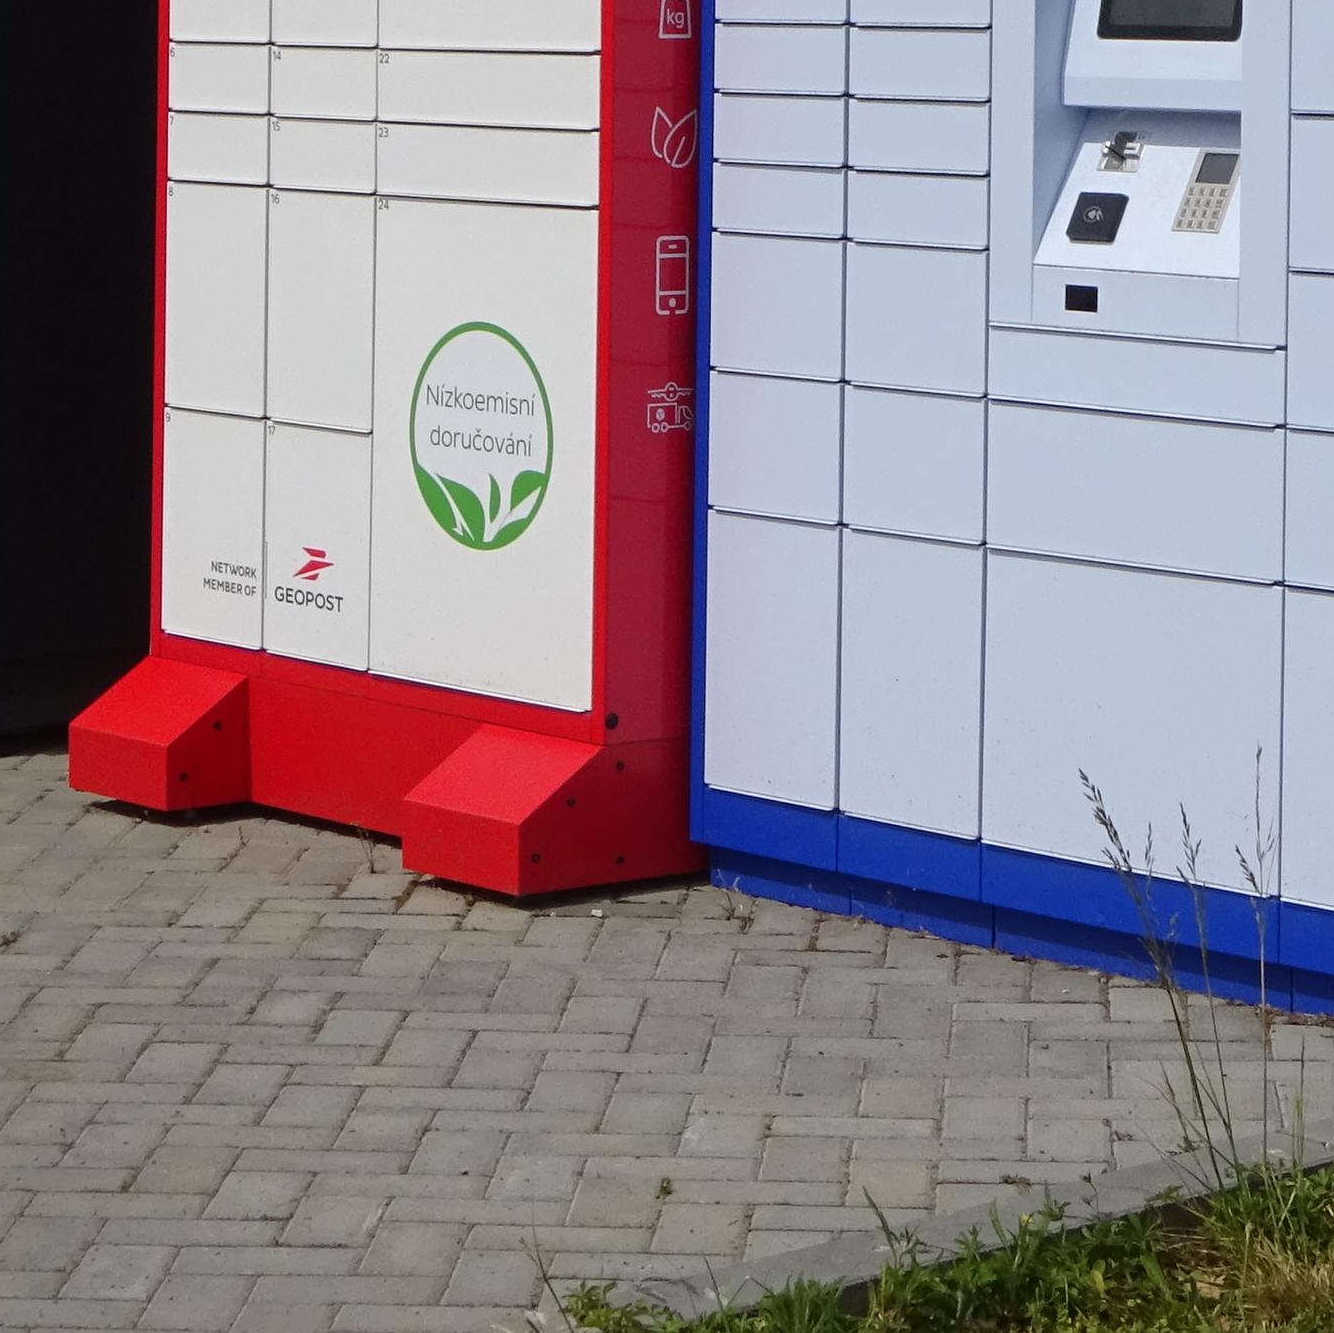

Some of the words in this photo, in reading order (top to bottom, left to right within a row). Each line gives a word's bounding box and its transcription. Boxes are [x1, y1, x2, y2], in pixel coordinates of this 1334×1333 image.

[667, 9, 685, 29] kg
[273, 51, 282, 60] 14
[378, 53, 389, 63] 22
[273, 121, 281, 131] 15
[378, 127, 389, 137] 23
[271, 193, 280, 203] 16
[378, 199, 389, 210] 24
[426, 382, 536, 417] Nízkoemisní
[267, 425, 276, 435] 17
[429, 425, 533, 458] doručování
[210, 559, 257, 579] NETWORK
[203, 577, 240, 595] MEMBER
[243, 584, 257, 597] OF
[274, 586, 343, 613] GEOPOST
